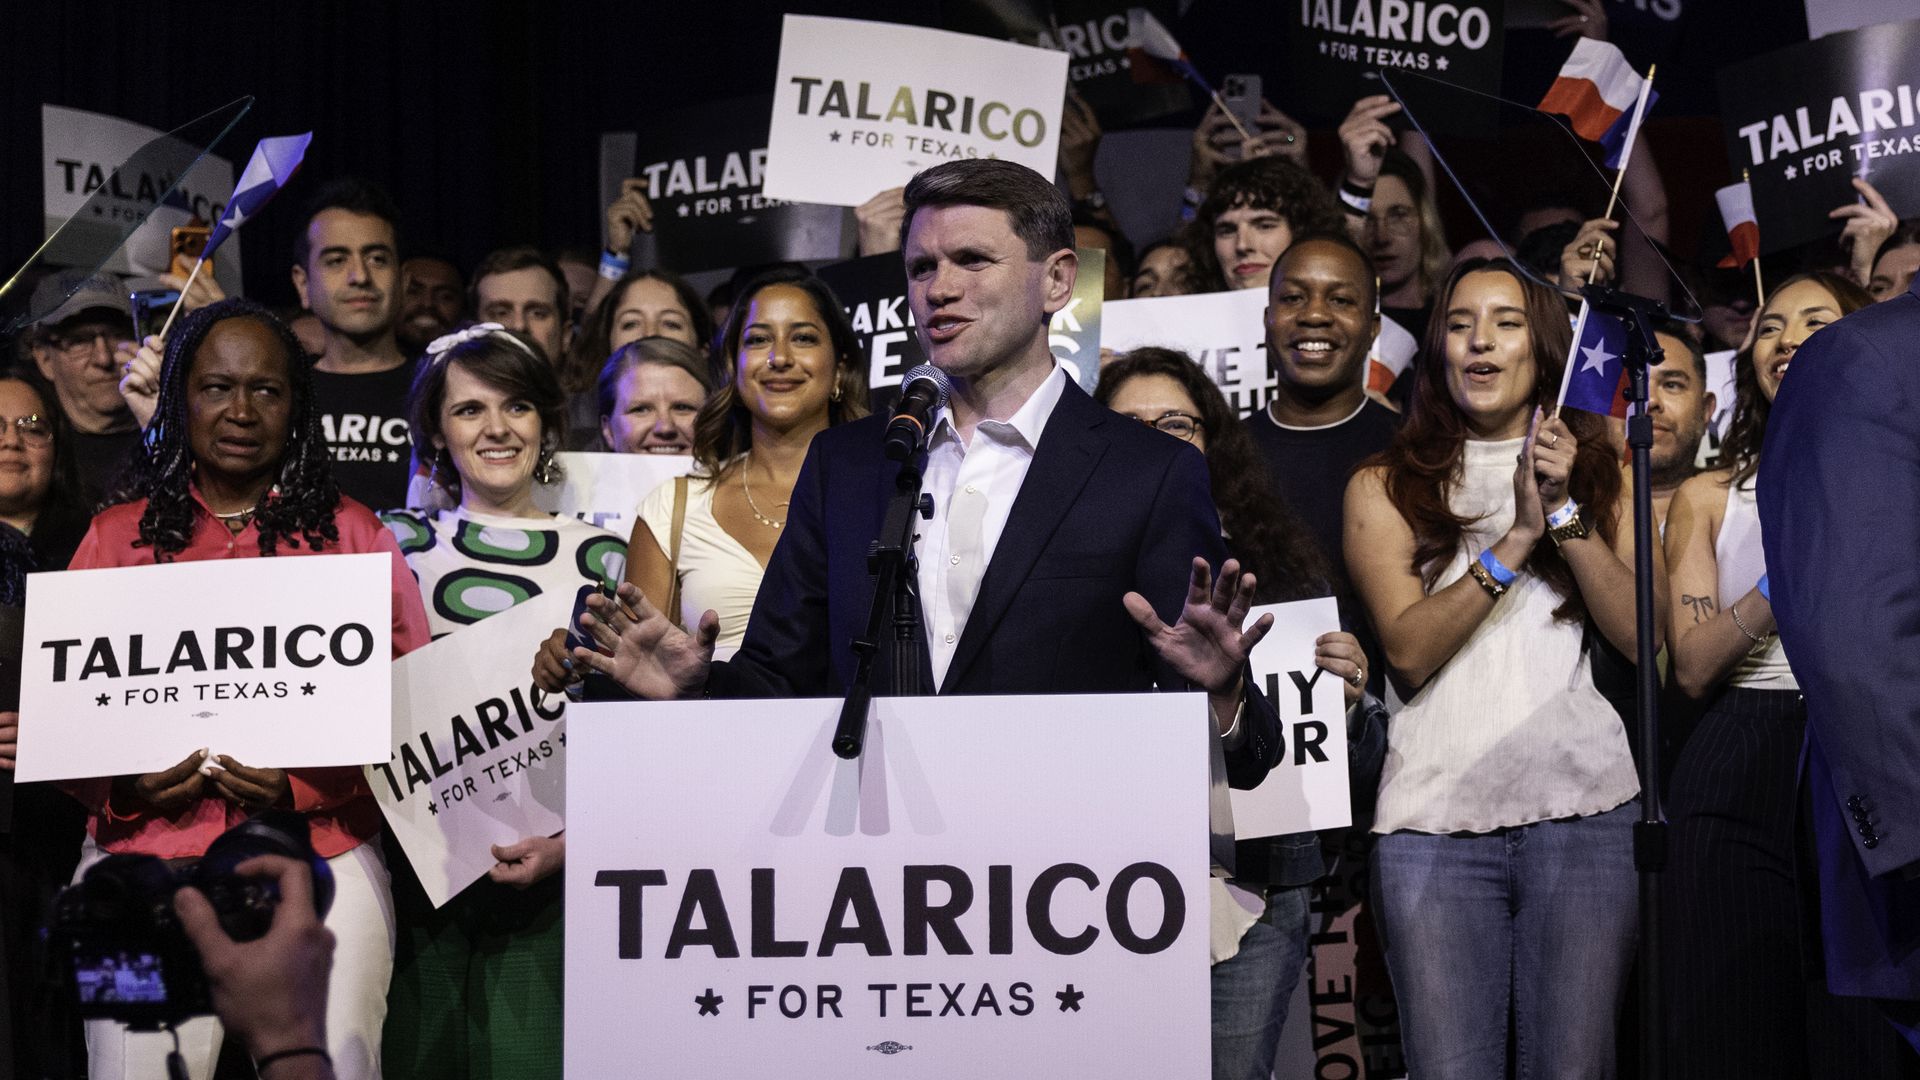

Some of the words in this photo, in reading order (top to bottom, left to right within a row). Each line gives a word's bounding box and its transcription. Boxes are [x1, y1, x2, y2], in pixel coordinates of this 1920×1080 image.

[1331, 41, 1358, 62] FOR
[1365, 46, 1430, 70] TEXAS
[791, 76, 1047, 148] TALARICO
[1738, 84, 1920, 166] TALARI
[852, 130, 895, 149] FOR
[906, 135, 978, 159] TEXAS
[1802, 149, 1843, 176] FOR
[695, 196, 732, 217] FOR
[41, 622, 374, 683] TALARICO
[124, 686, 180, 706] FOR
[193, 681, 289, 701] TEXAS
[374, 681, 574, 803] TALARIC
[440, 775, 478, 809] FOR
[482, 739, 553, 785] TEXAS
[594, 861, 1186, 960] TALARICO
[747, 984, 843, 1019] FOR
[868, 982, 1035, 1018] TEXAS
